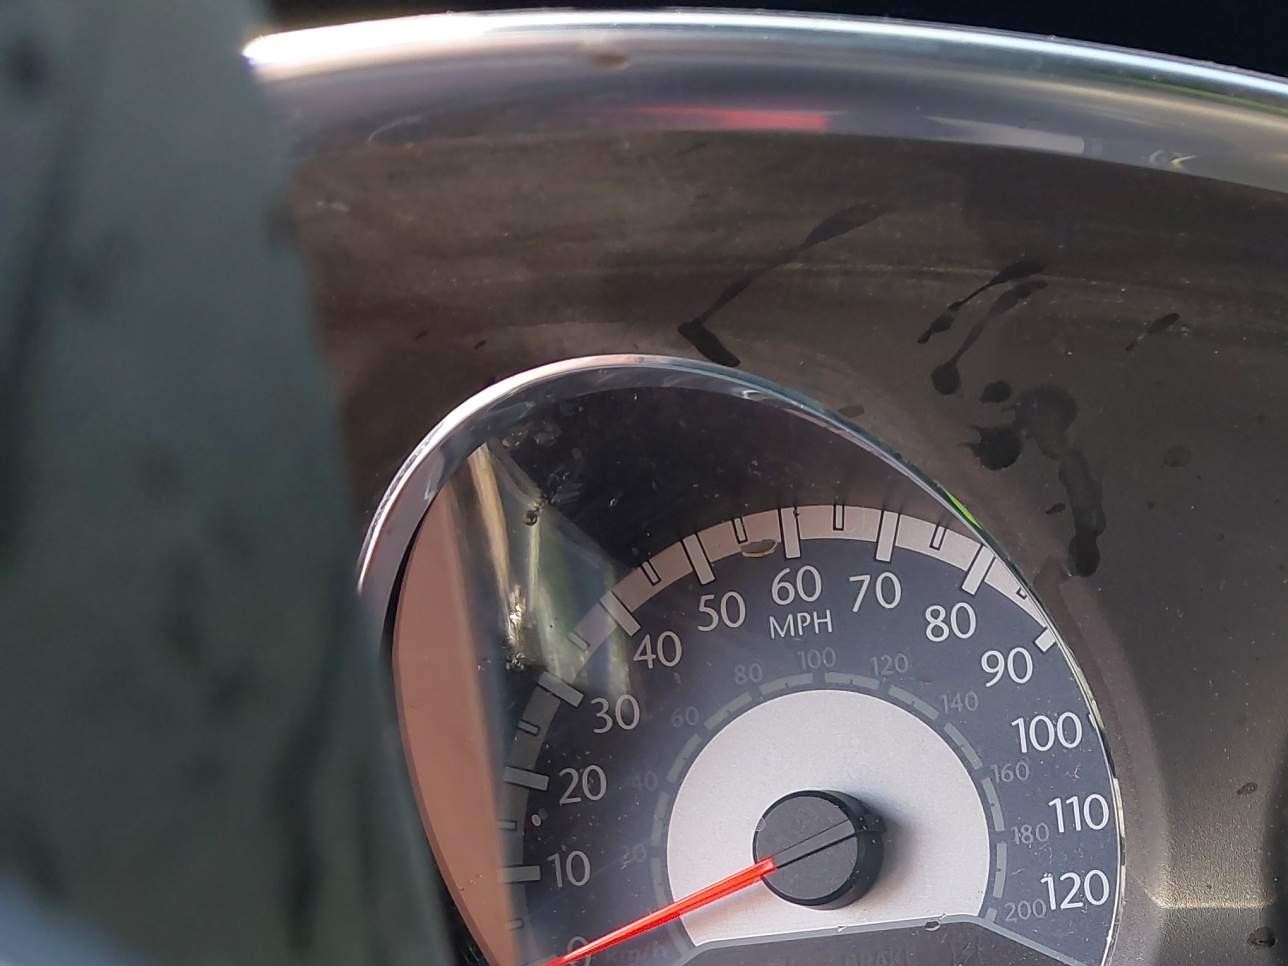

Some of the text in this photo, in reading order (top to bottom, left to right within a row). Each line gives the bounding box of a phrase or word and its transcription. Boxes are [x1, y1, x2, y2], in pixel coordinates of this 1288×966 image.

[770, 565, 823, 606] 60
[849, 571, 902, 613] 70
[697, 591, 747, 632] 50
[768, 609, 833, 640] MPH
[924, 601, 977, 642] 80
[632, 631, 683, 669] 40
[796, 647, 837, 671] 100
[870, 653, 910, 678] 120
[980, 647, 1034, 688] 90
[734, 663, 763, 686] 80
[590, 694, 640, 734] 30
[670, 705, 699, 727] 60
[941, 691, 980, 714] 140
[1010, 711, 1084, 753] 100
[558, 764, 608, 806] 20
[991, 761, 1030, 783] 160
[1048, 794, 1110, 833] 110
[1010, 822, 1050, 845] 180
[547, 849, 592, 889] 10
[1040, 869, 1110, 911] 120
[1004, 899, 1048, 923] 200
